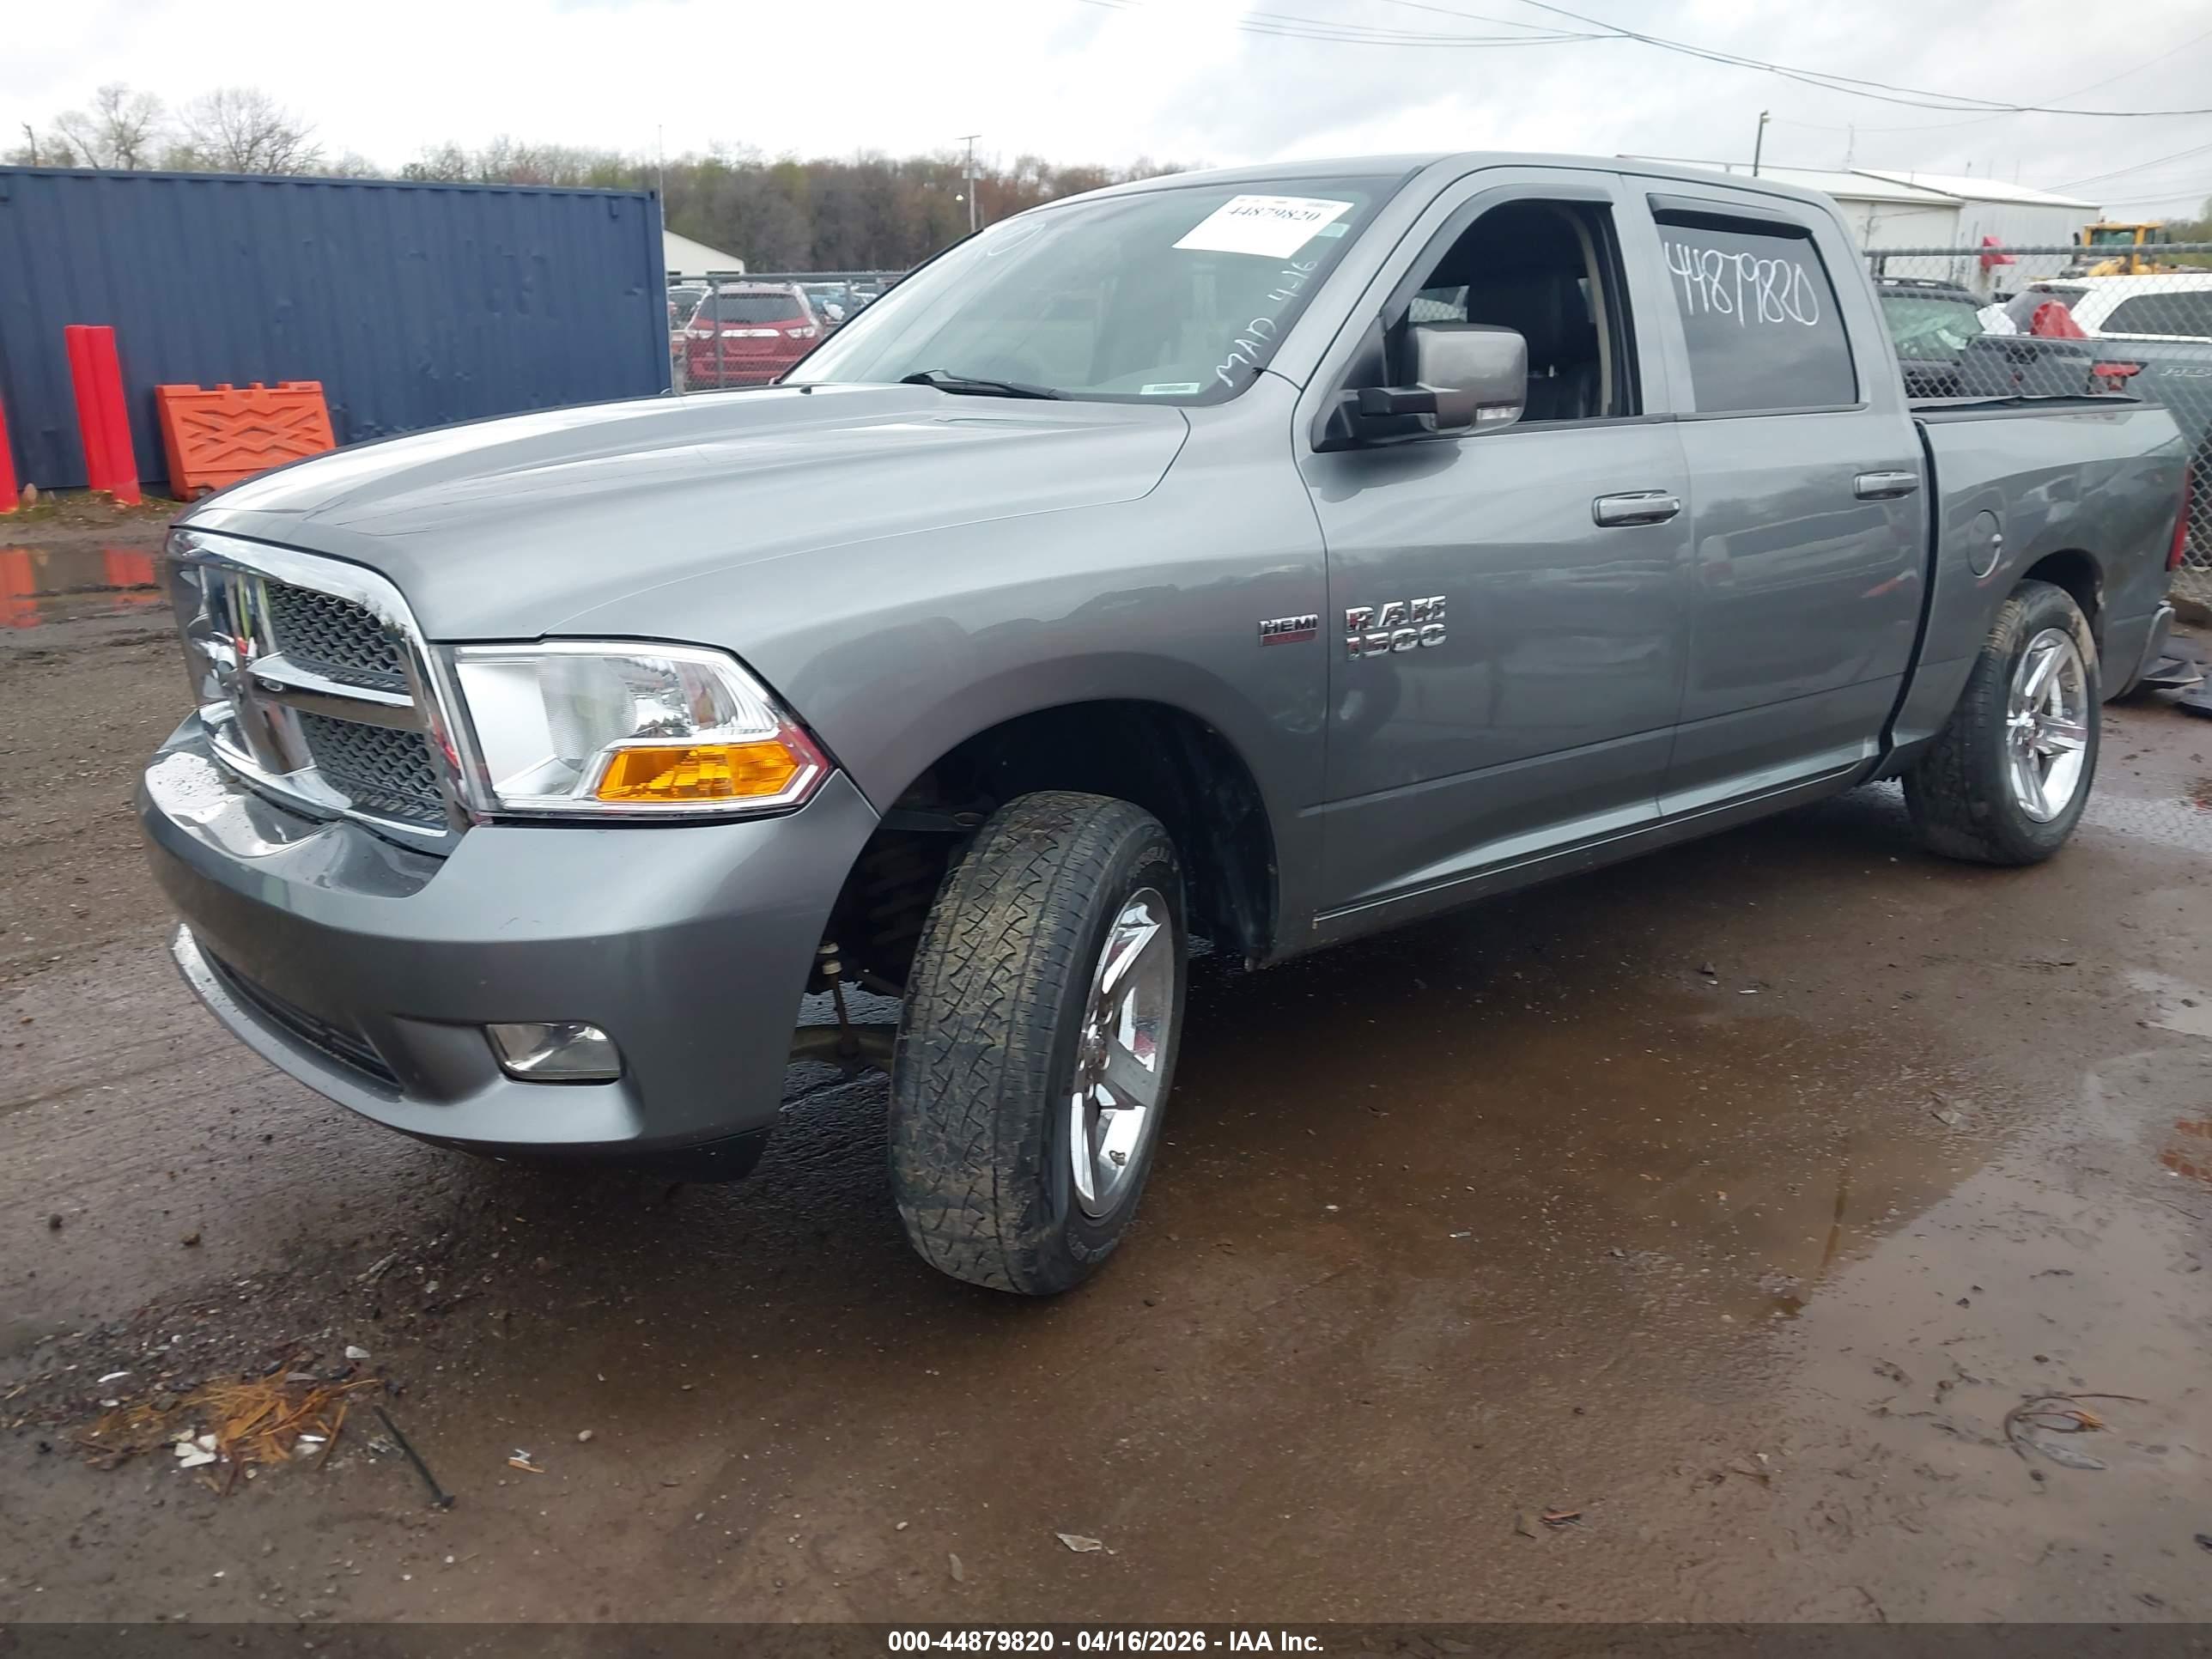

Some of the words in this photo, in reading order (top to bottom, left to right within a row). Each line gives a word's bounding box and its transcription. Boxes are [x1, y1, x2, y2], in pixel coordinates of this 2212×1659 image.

[1228, 205, 1322, 222] 44879820
[1663, 241, 1820, 328] 44879820
[1216, 317, 1278, 387] MAD
[1267, 260, 1319, 301] 4-16
[1257, 613, 1319, 636] HEMI
[1345, 595, 1447, 634] RAM
[1345, 623, 1448, 660] 1500
